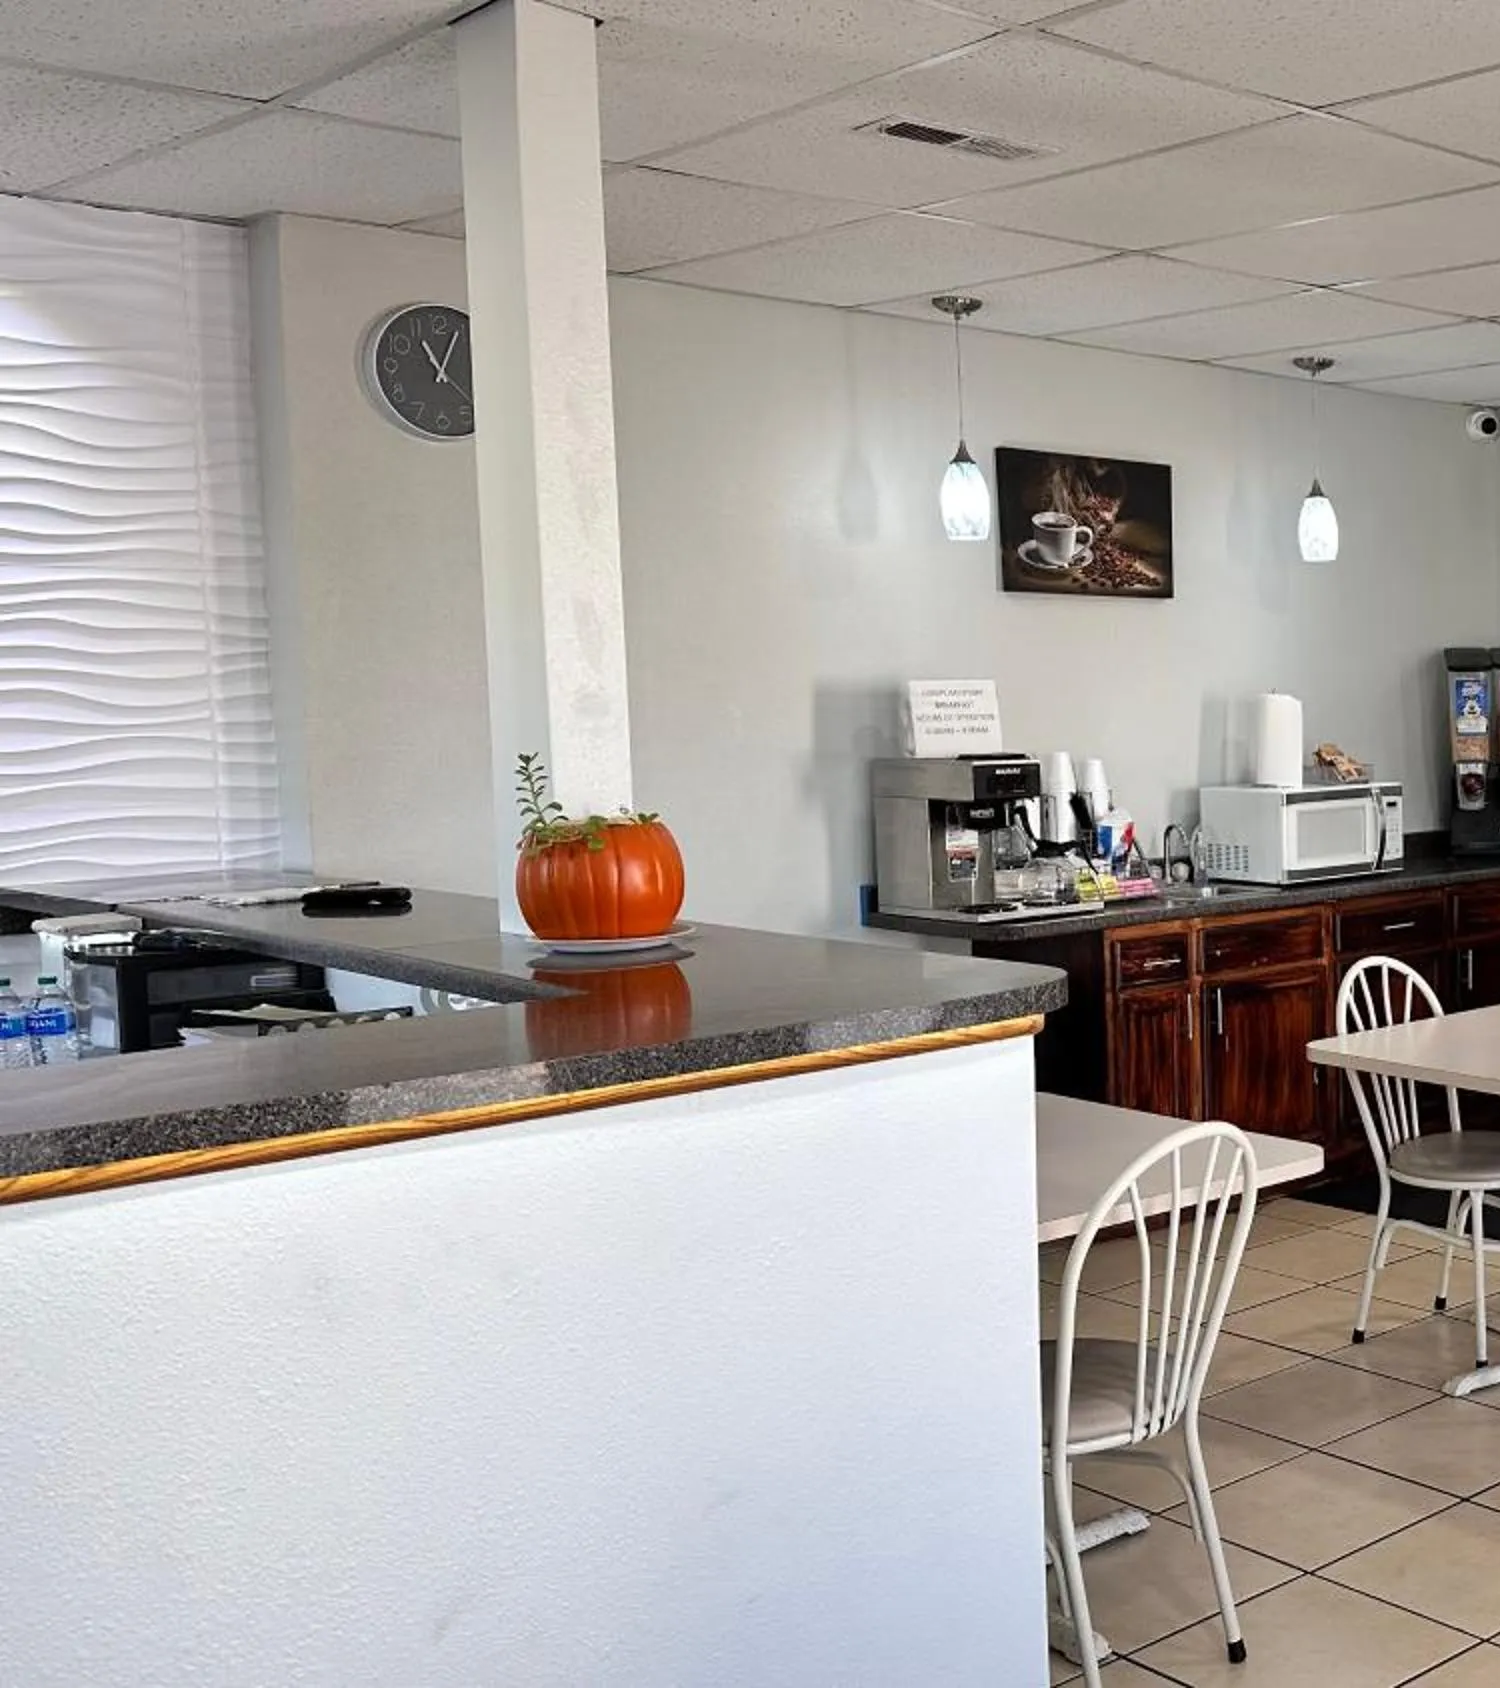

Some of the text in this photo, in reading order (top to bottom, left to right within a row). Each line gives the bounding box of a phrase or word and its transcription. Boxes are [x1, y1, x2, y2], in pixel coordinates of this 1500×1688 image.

[409, 318, 421, 337] 11
[388, 332, 411, 355] 10
[383, 357, 398, 382] 9
[391, 383, 405, 402] 8
[409, 401, 426, 421] 7
[435, 411, 452, 430] 6
